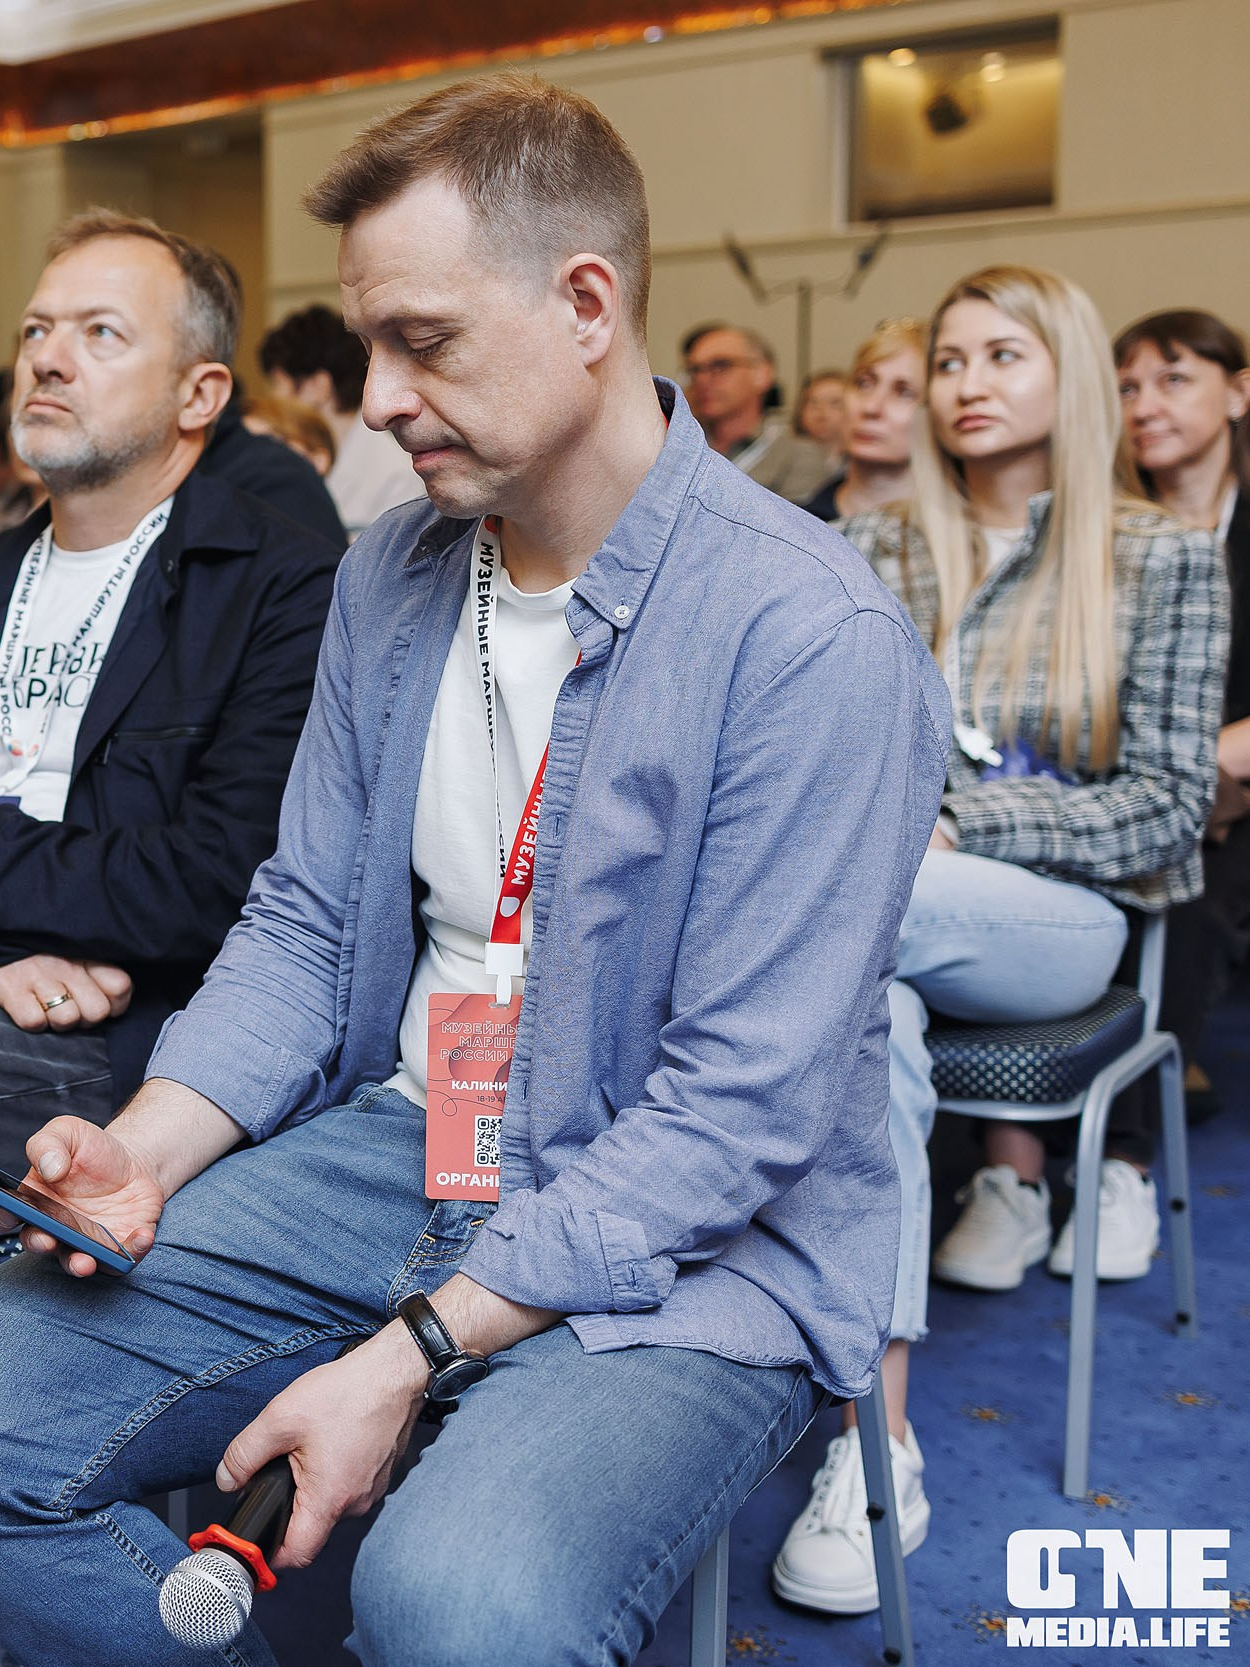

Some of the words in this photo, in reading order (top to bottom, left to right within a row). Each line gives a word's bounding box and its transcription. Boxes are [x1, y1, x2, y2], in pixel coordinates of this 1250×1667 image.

[72, 566, 126, 647] МАРШРУТЫ
[124, 513, 169, 565] РОССИИ
[477, 540, 497, 655] МУЗЕЙНЫЕ
[440, 1048, 508, 1062] РОССИИ
[477, 1095, 496, 1103] 18-19
